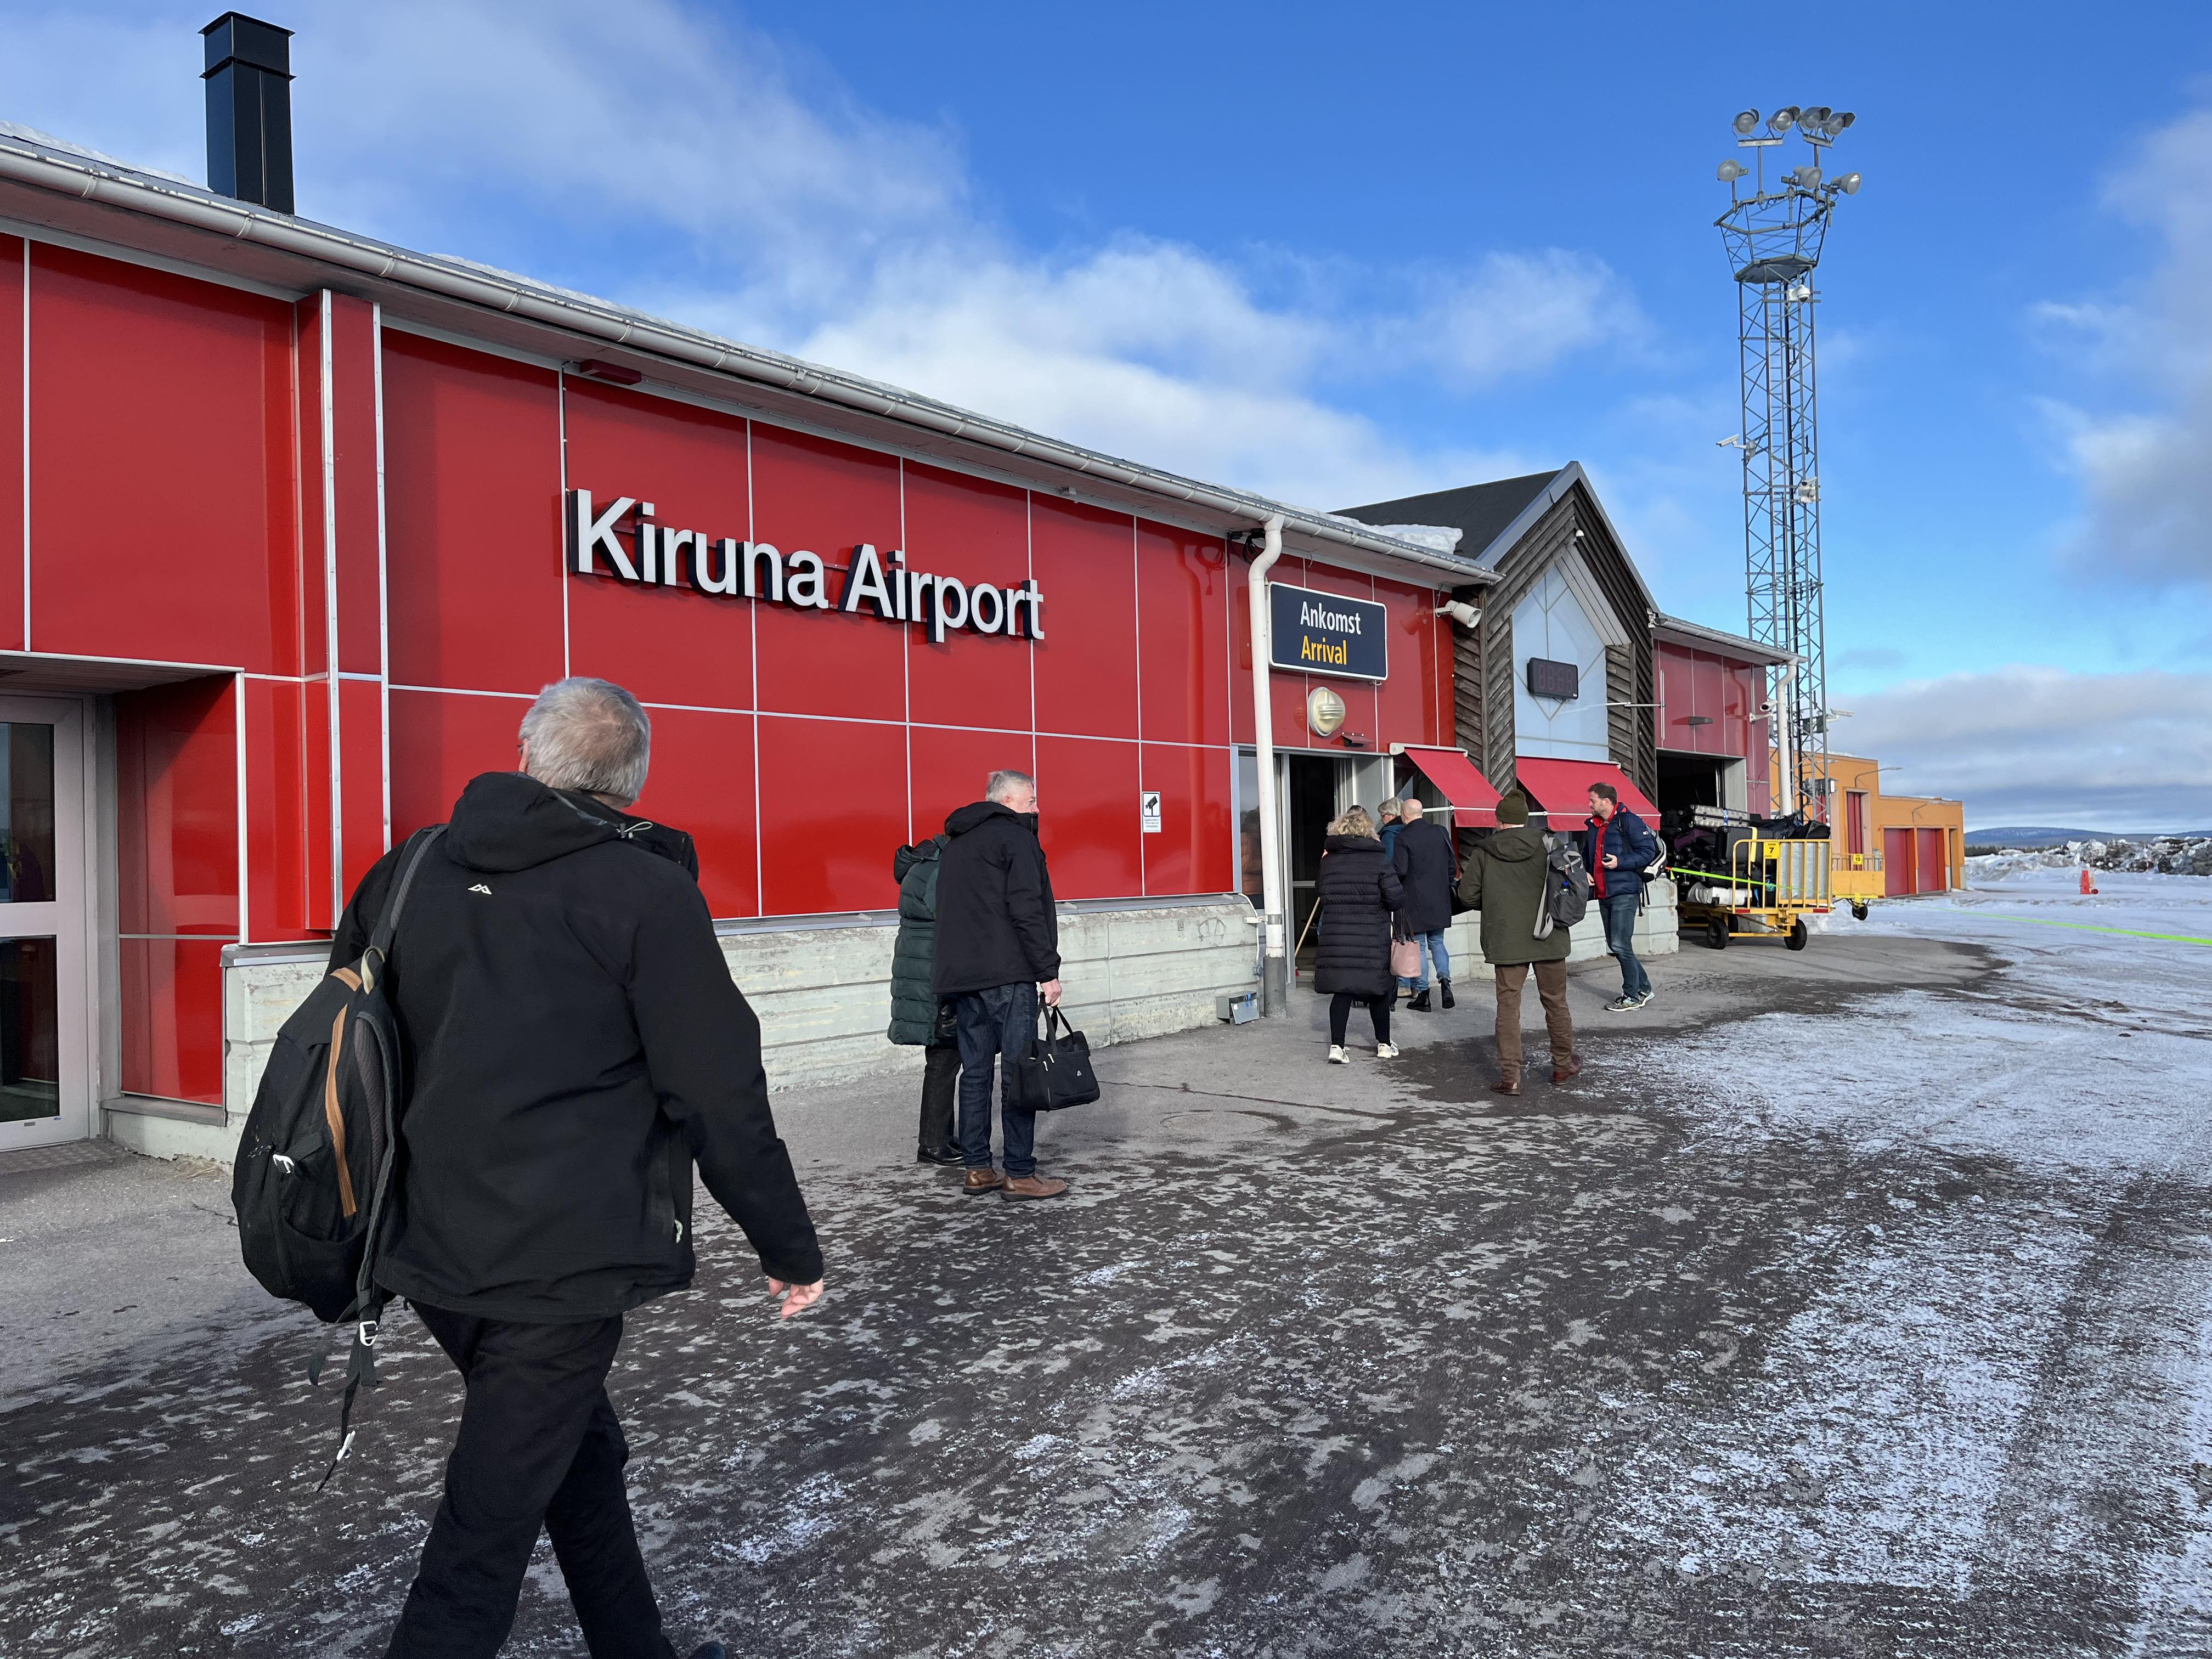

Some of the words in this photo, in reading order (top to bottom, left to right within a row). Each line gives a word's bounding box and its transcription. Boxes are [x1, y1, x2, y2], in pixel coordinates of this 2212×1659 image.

[570, 488, 829, 610] Kiruna
[839, 543, 1045, 644] Airport
[1300, 601, 1361, 635] Ankomst
[1301, 635, 1347, 665] Arrival
